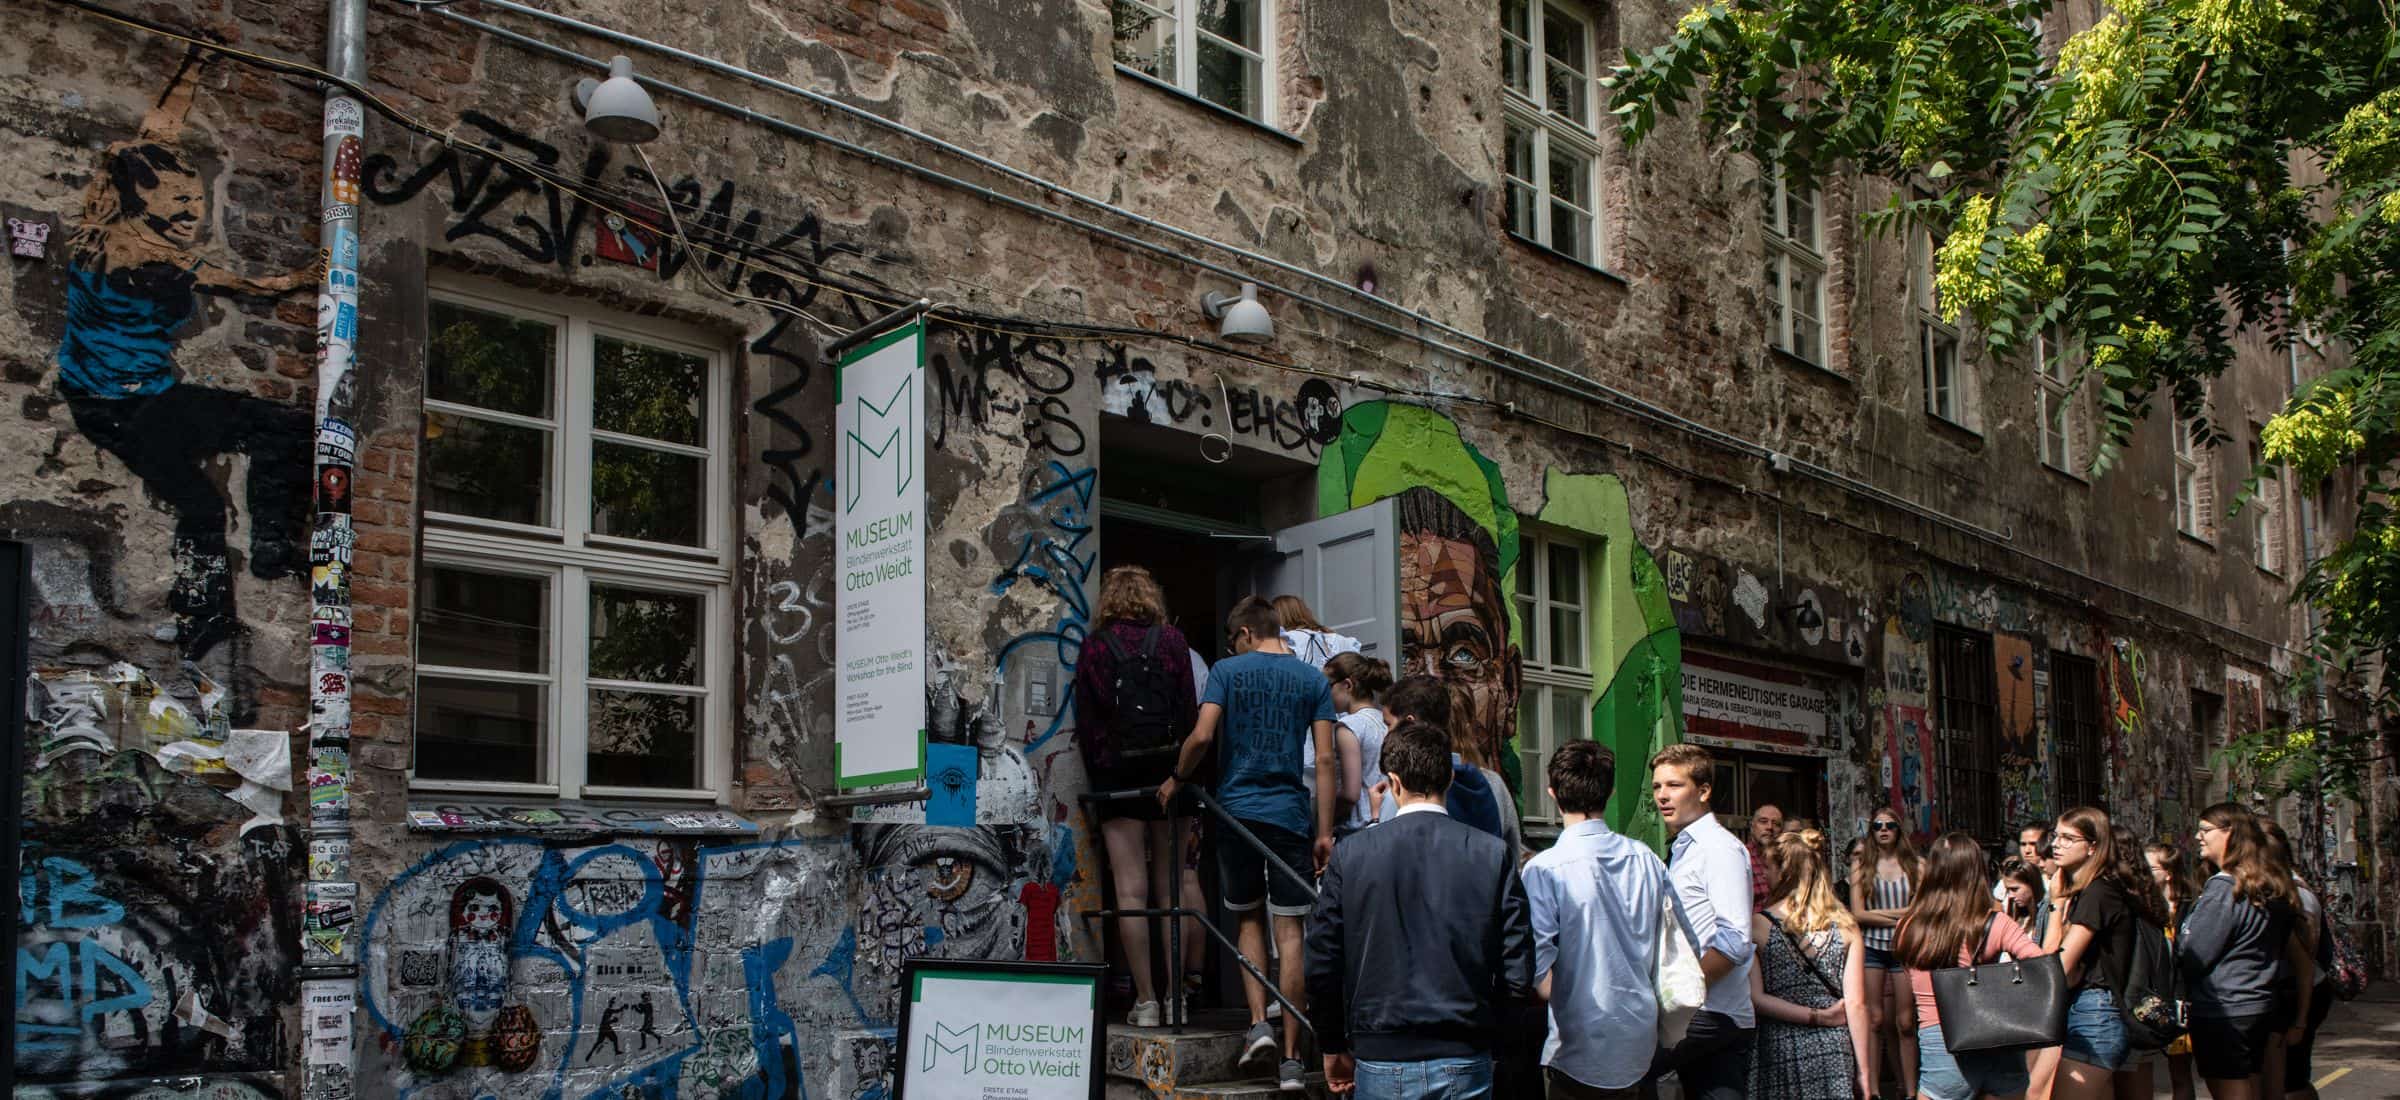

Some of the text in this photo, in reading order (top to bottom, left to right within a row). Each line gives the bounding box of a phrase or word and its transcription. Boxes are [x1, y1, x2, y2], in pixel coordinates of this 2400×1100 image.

[847, 510, 912, 552] MUSEUM
[847, 536, 912, 569] Blindenwerkstatt
[847, 555, 912, 591] Otto Weidt
[1680, 672, 1825, 714] DIE HERMENEUTISCHE GARAGE
[986, 1023, 1084, 1044] MUSEUM
[983, 1058, 1080, 1077] Otto Weidt
[985, 1044, 1081, 1059] Blindenwerkstatt
